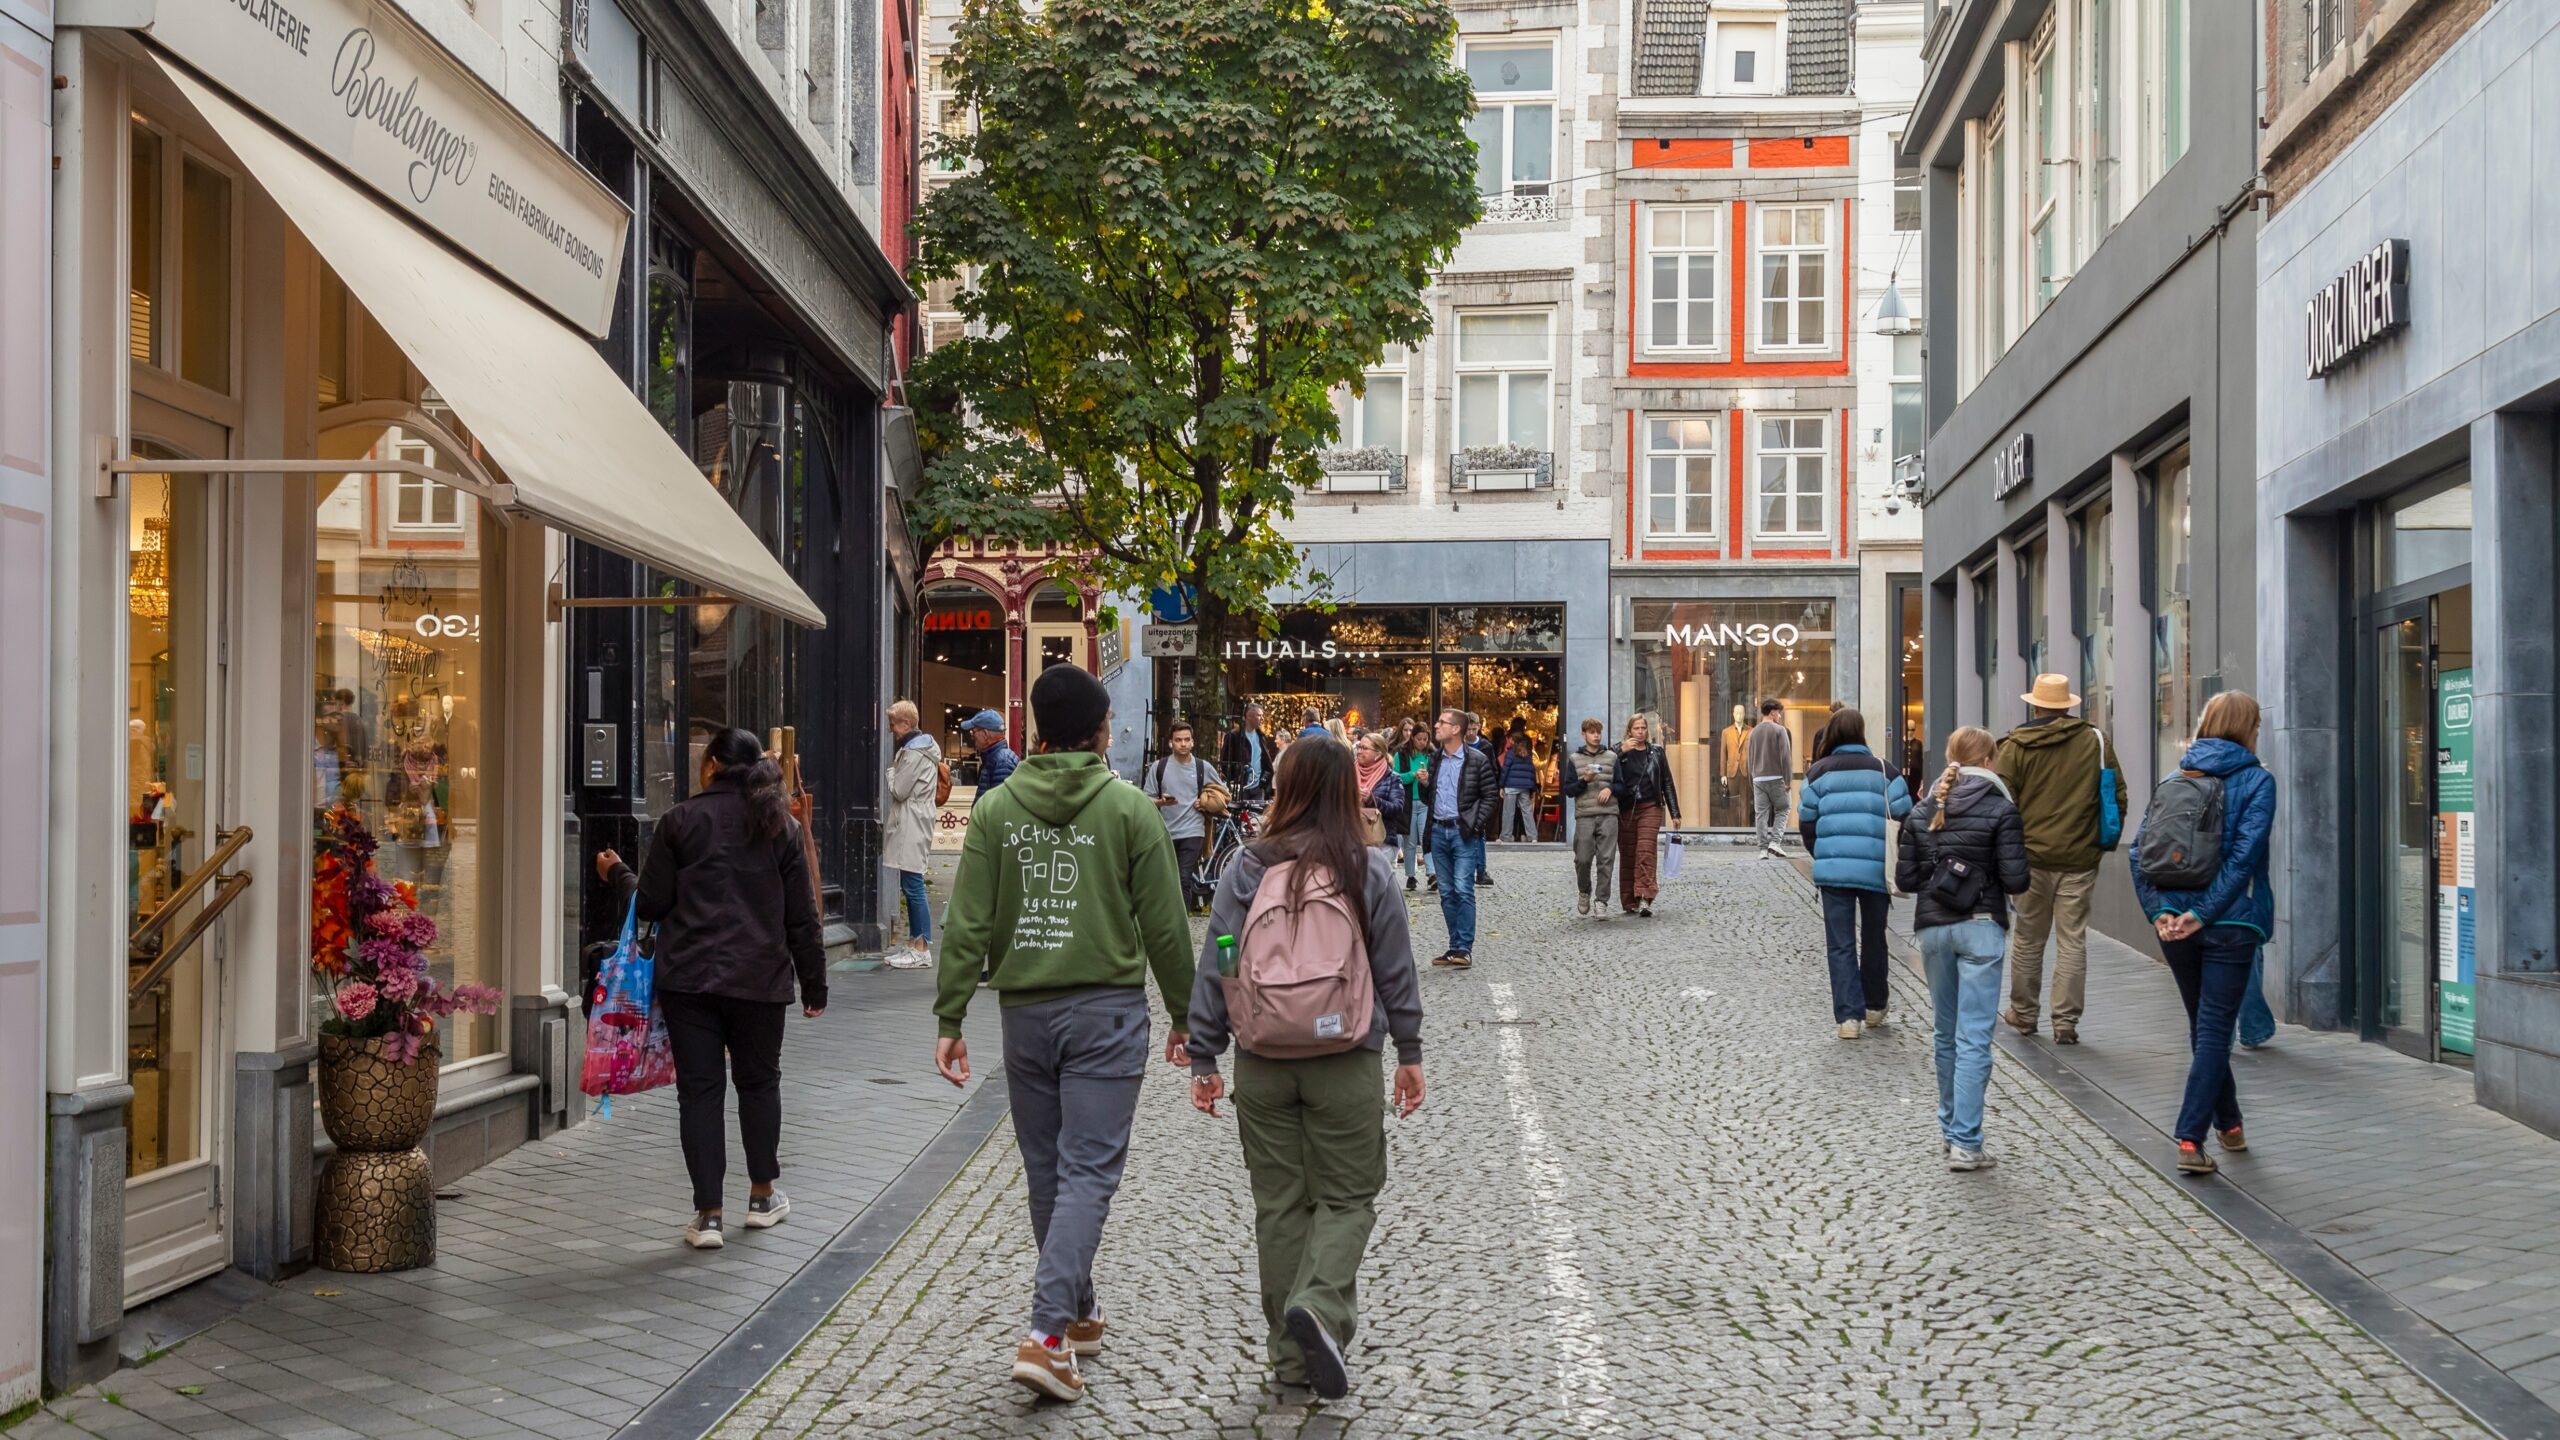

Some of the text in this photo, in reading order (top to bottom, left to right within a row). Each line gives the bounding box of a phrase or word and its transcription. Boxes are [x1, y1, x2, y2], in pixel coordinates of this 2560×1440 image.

[229, 0, 311, 57] LATERIE
[488, 172, 604, 280] EIGEN FABRIKAAT BONBONS
[2305, 238, 2394, 380] DURLINGER
[1225, 640, 1381, 660] ITUALS...
[1666, 622, 1799, 647] MANGO
